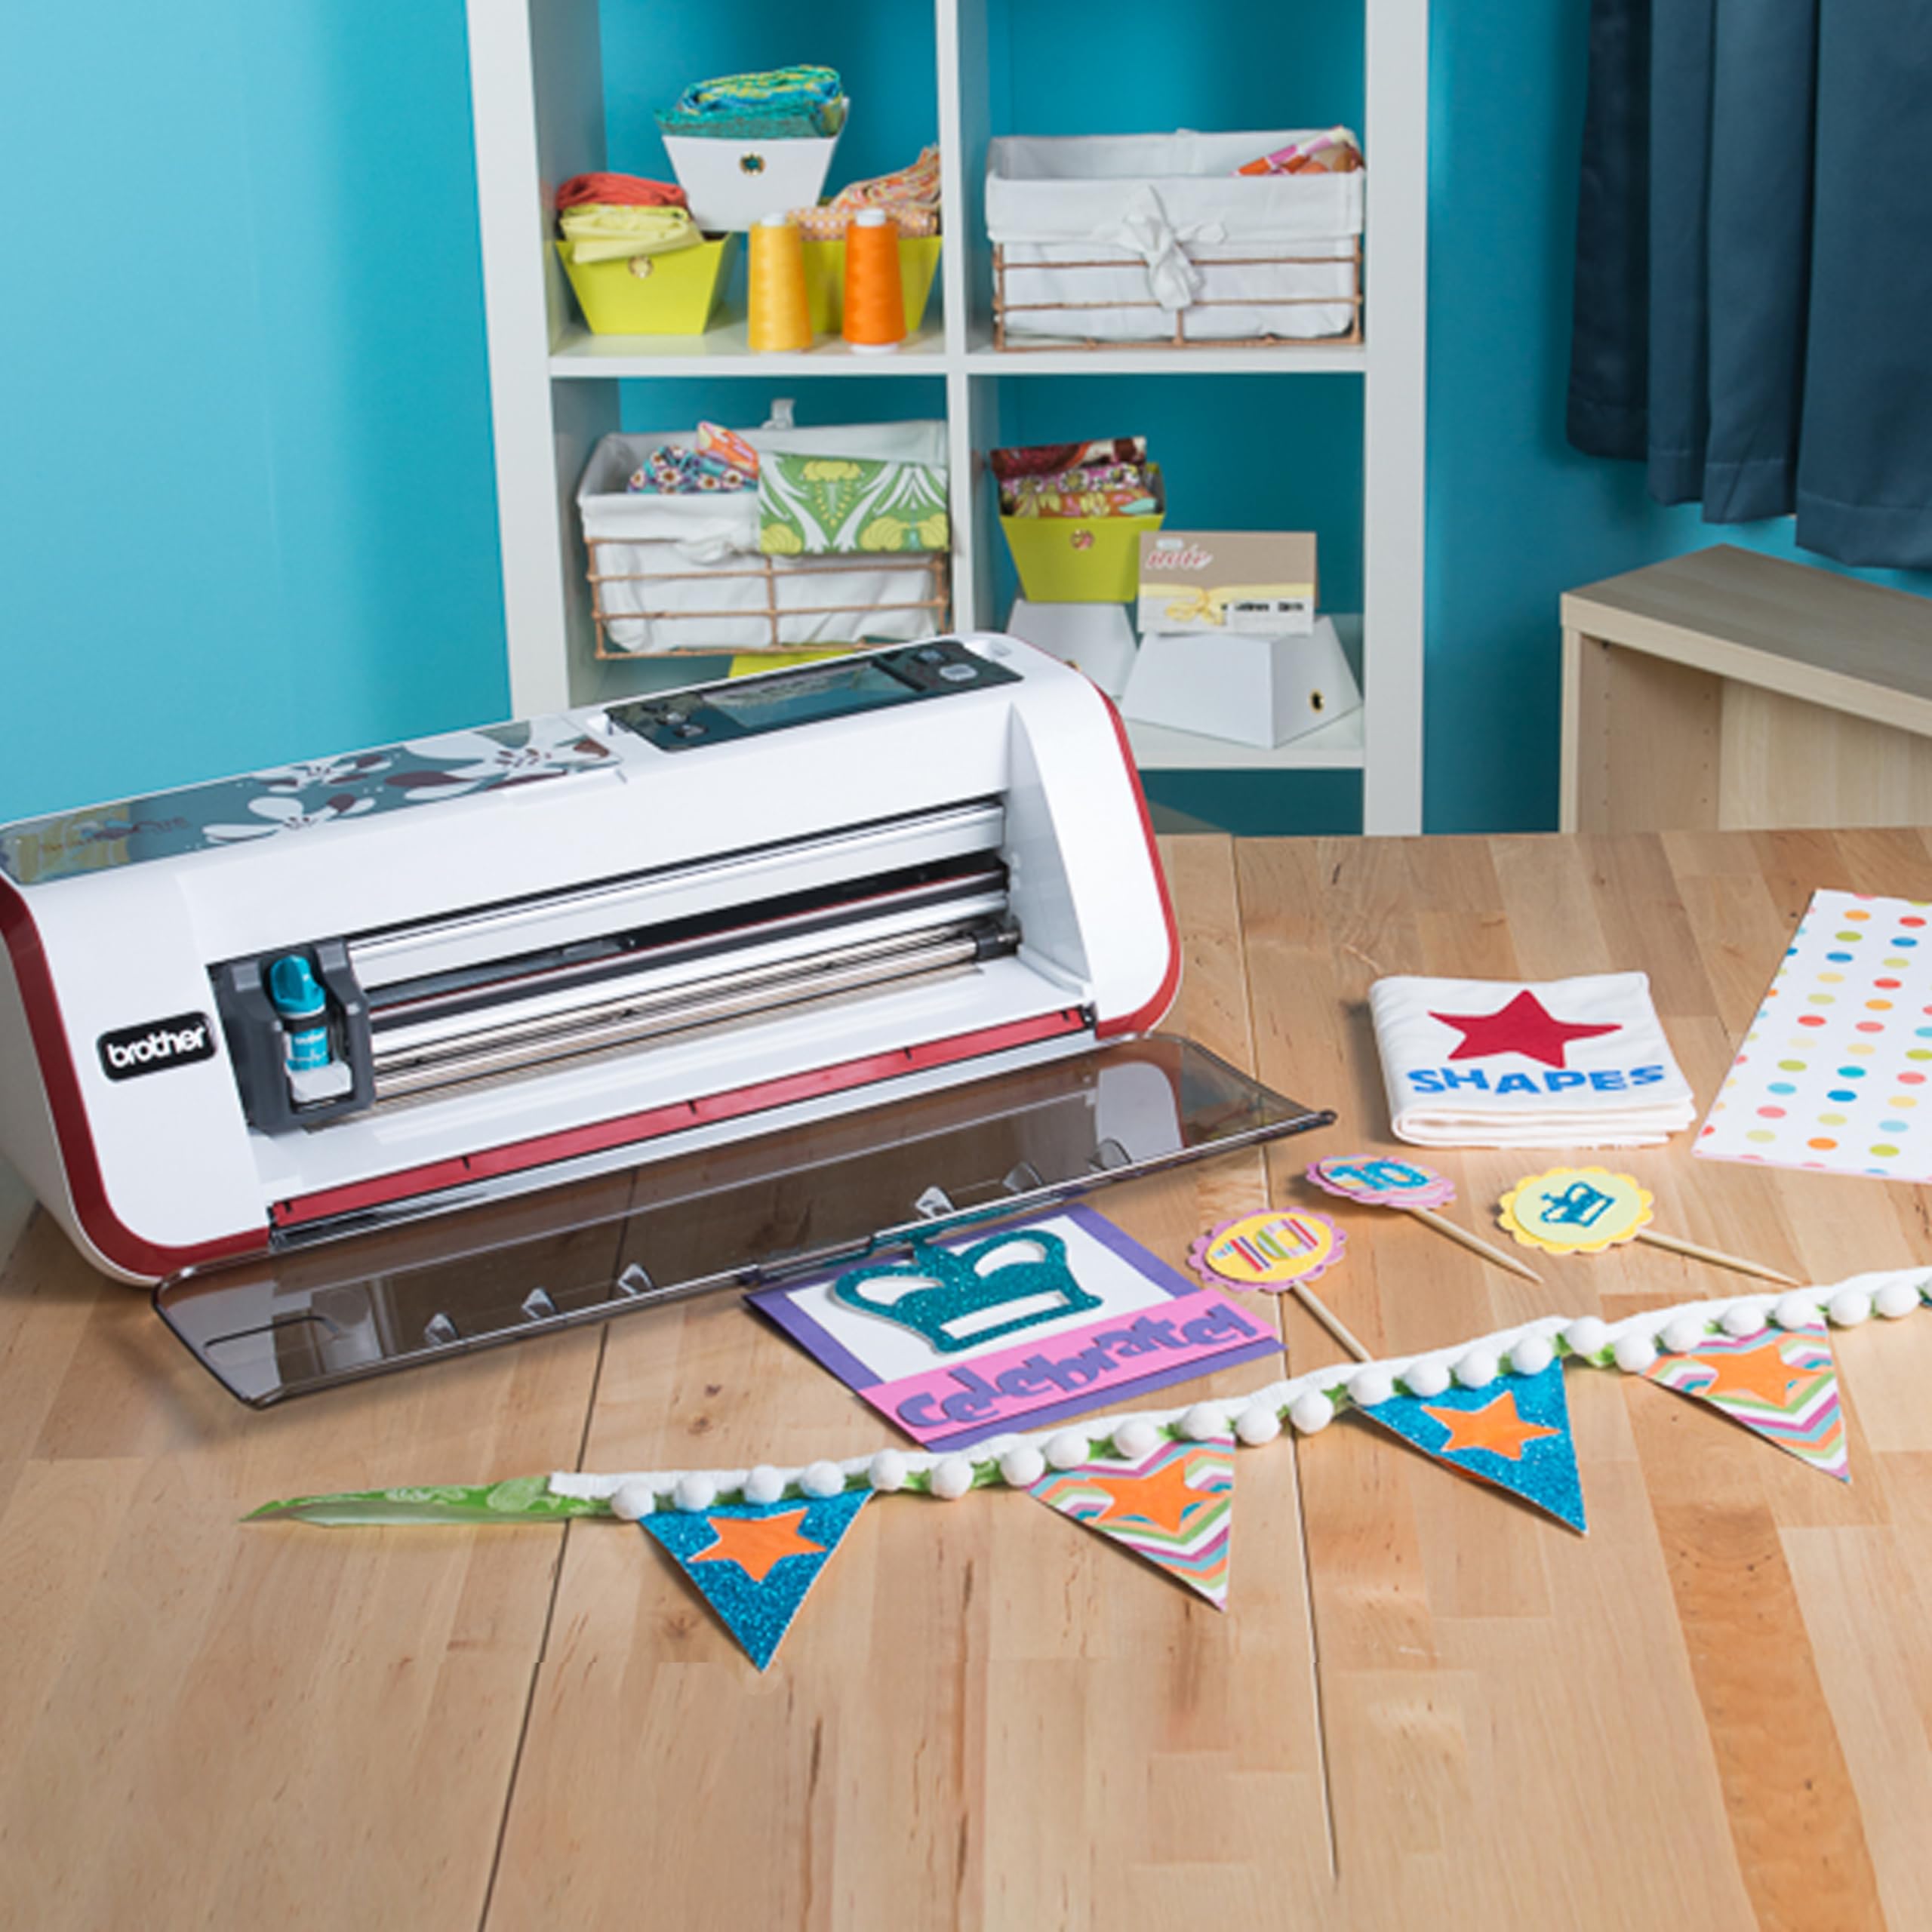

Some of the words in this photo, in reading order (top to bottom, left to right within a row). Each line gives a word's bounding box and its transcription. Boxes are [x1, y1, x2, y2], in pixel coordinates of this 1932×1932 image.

[107, 1026, 206, 1068] brother
[1407, 1064, 1666, 1094] SHAPES
[1328, 1161, 1430, 1192] 10
[1211, 1217, 1321, 1274] 10
